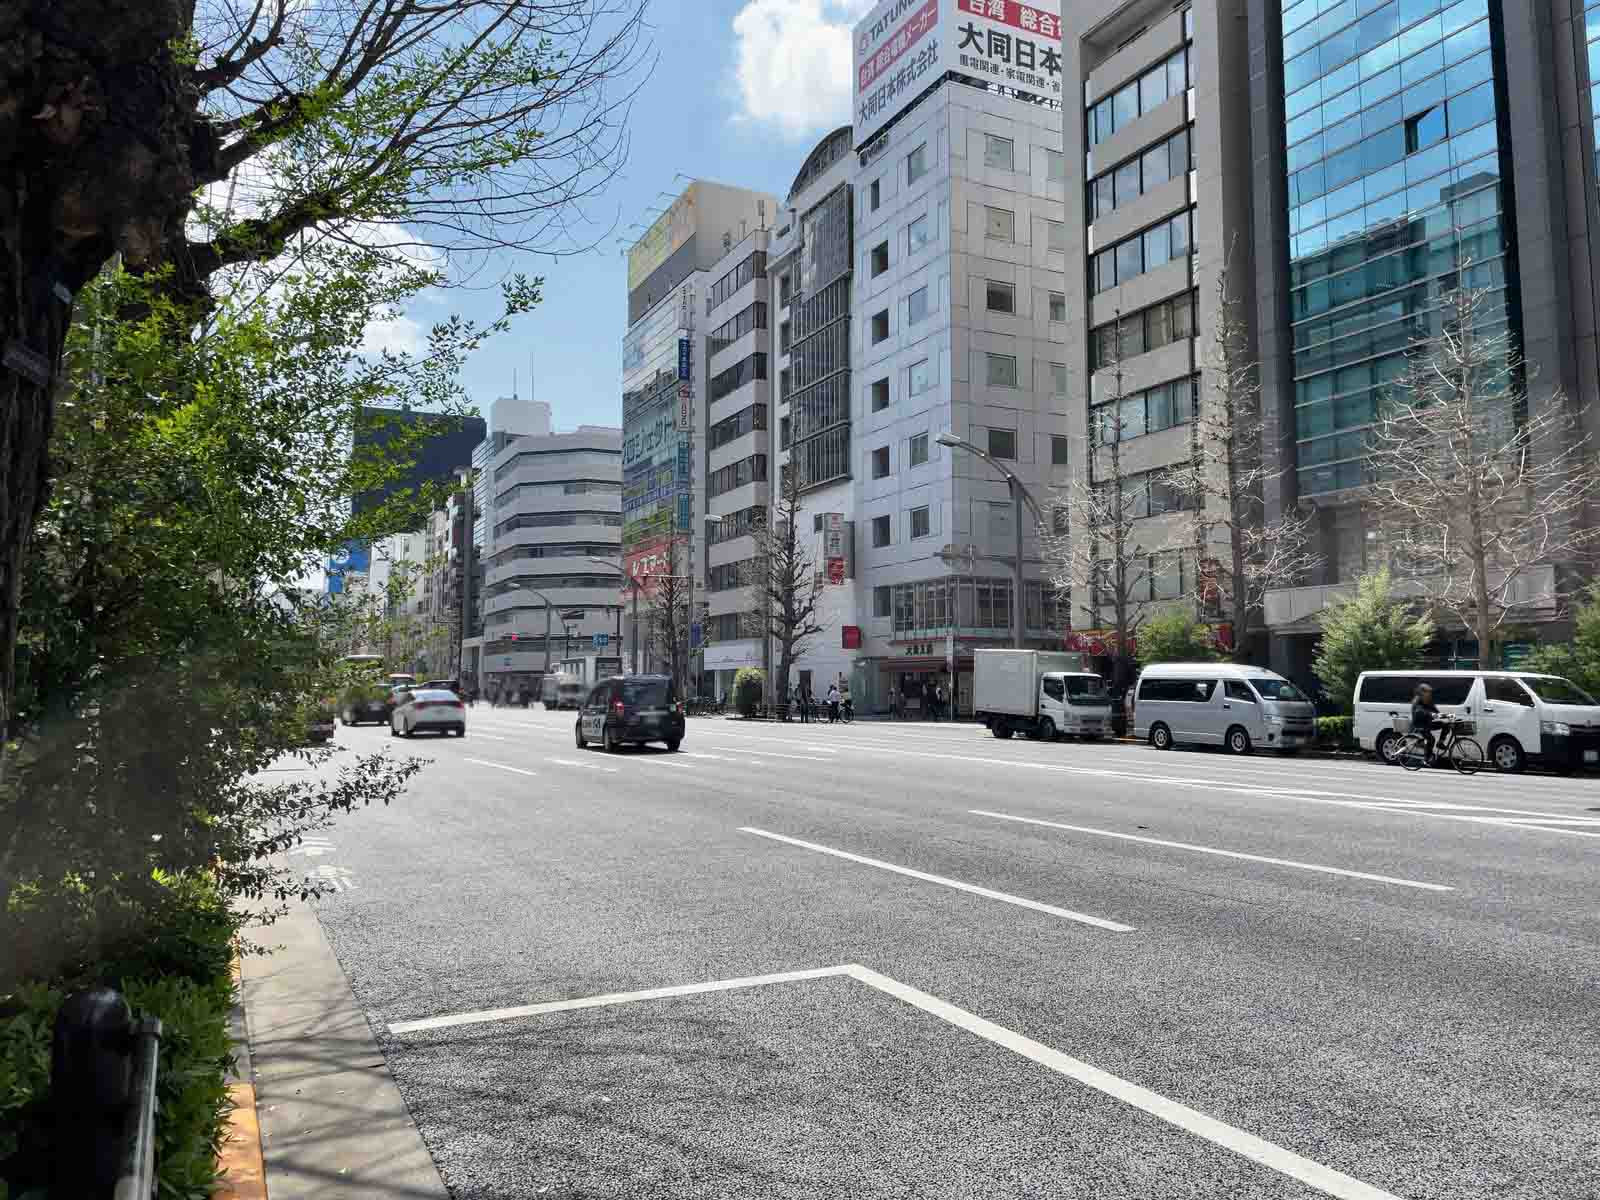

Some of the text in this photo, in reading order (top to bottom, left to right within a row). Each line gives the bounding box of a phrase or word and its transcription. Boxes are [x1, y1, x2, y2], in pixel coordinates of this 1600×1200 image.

[870, 0, 914, 41] TATUN
[1020, 7, 1062, 36] 総合
[958, 22, 1062, 77] 大同日本
[859, 39, 939, 128] 大同日本株式会社
